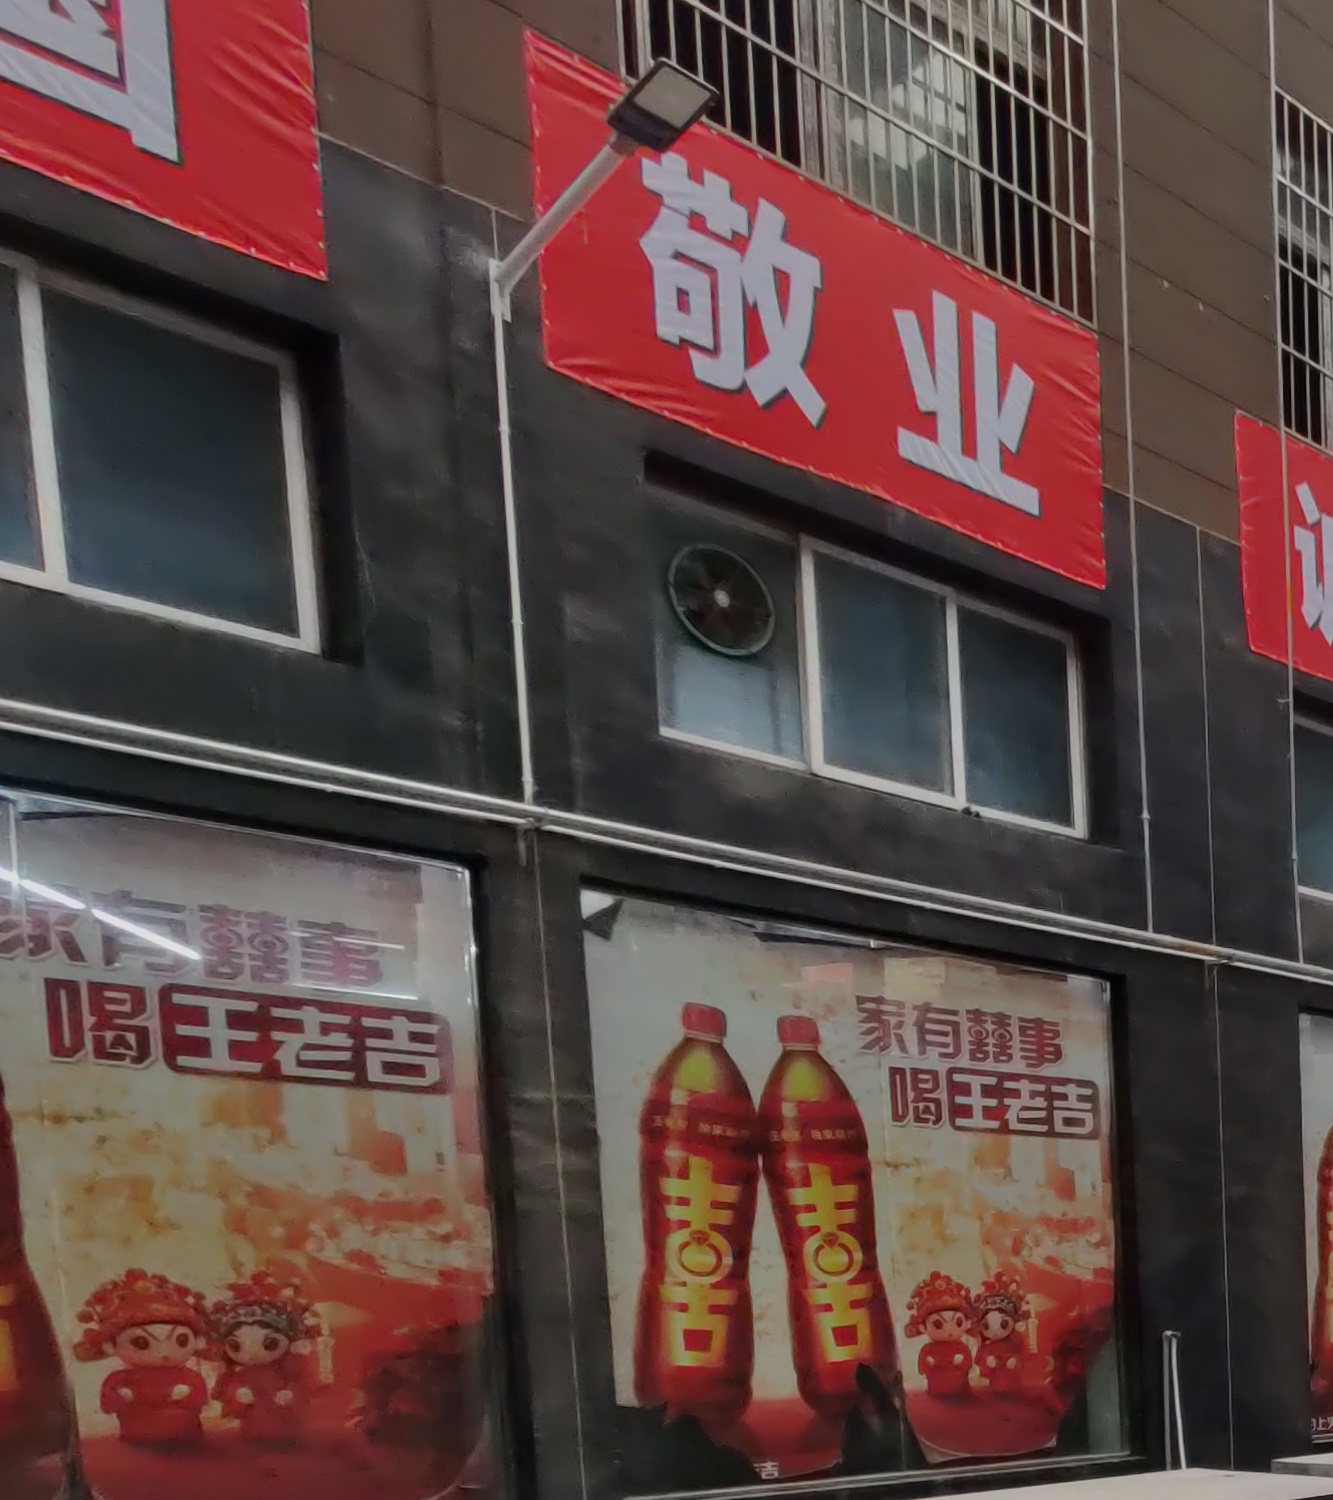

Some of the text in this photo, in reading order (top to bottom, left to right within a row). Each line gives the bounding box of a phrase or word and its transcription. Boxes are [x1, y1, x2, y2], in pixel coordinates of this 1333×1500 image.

[639, 150, 1041, 518] 敬业
[44, 977, 452, 1094] 喝王老吉
[888, 1065, 1100, 1141] 喝王老吉
